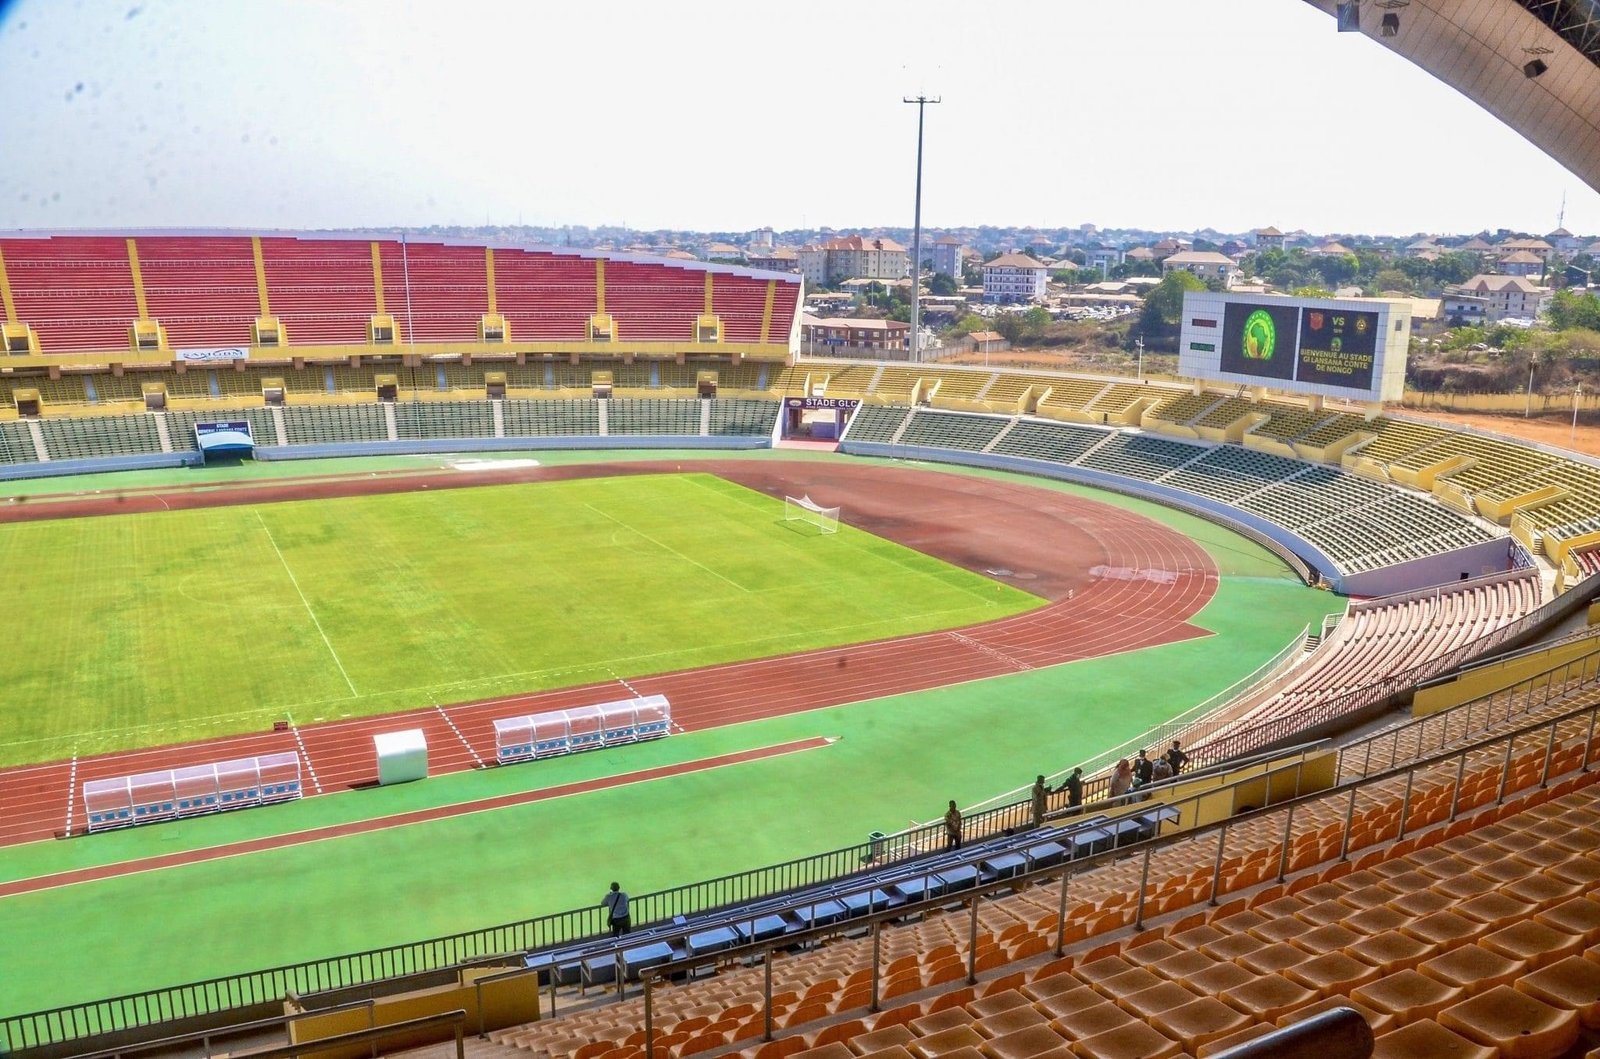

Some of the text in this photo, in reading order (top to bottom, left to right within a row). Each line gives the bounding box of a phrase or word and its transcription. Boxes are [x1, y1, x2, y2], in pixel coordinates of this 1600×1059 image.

[1332, 317, 1345, 326] VS
[1300, 348, 1337, 358] BIENVENUE
[1338, 352, 1348, 360] AU
[1349, 353, 1373, 362] STADE
[1311, 357, 1342, 366] LANSANA
[1343, 361, 1368, 369] CONTE
[1316, 364, 1352, 374] DE NONGO
[806, 398, 857, 408] STADE GLC
